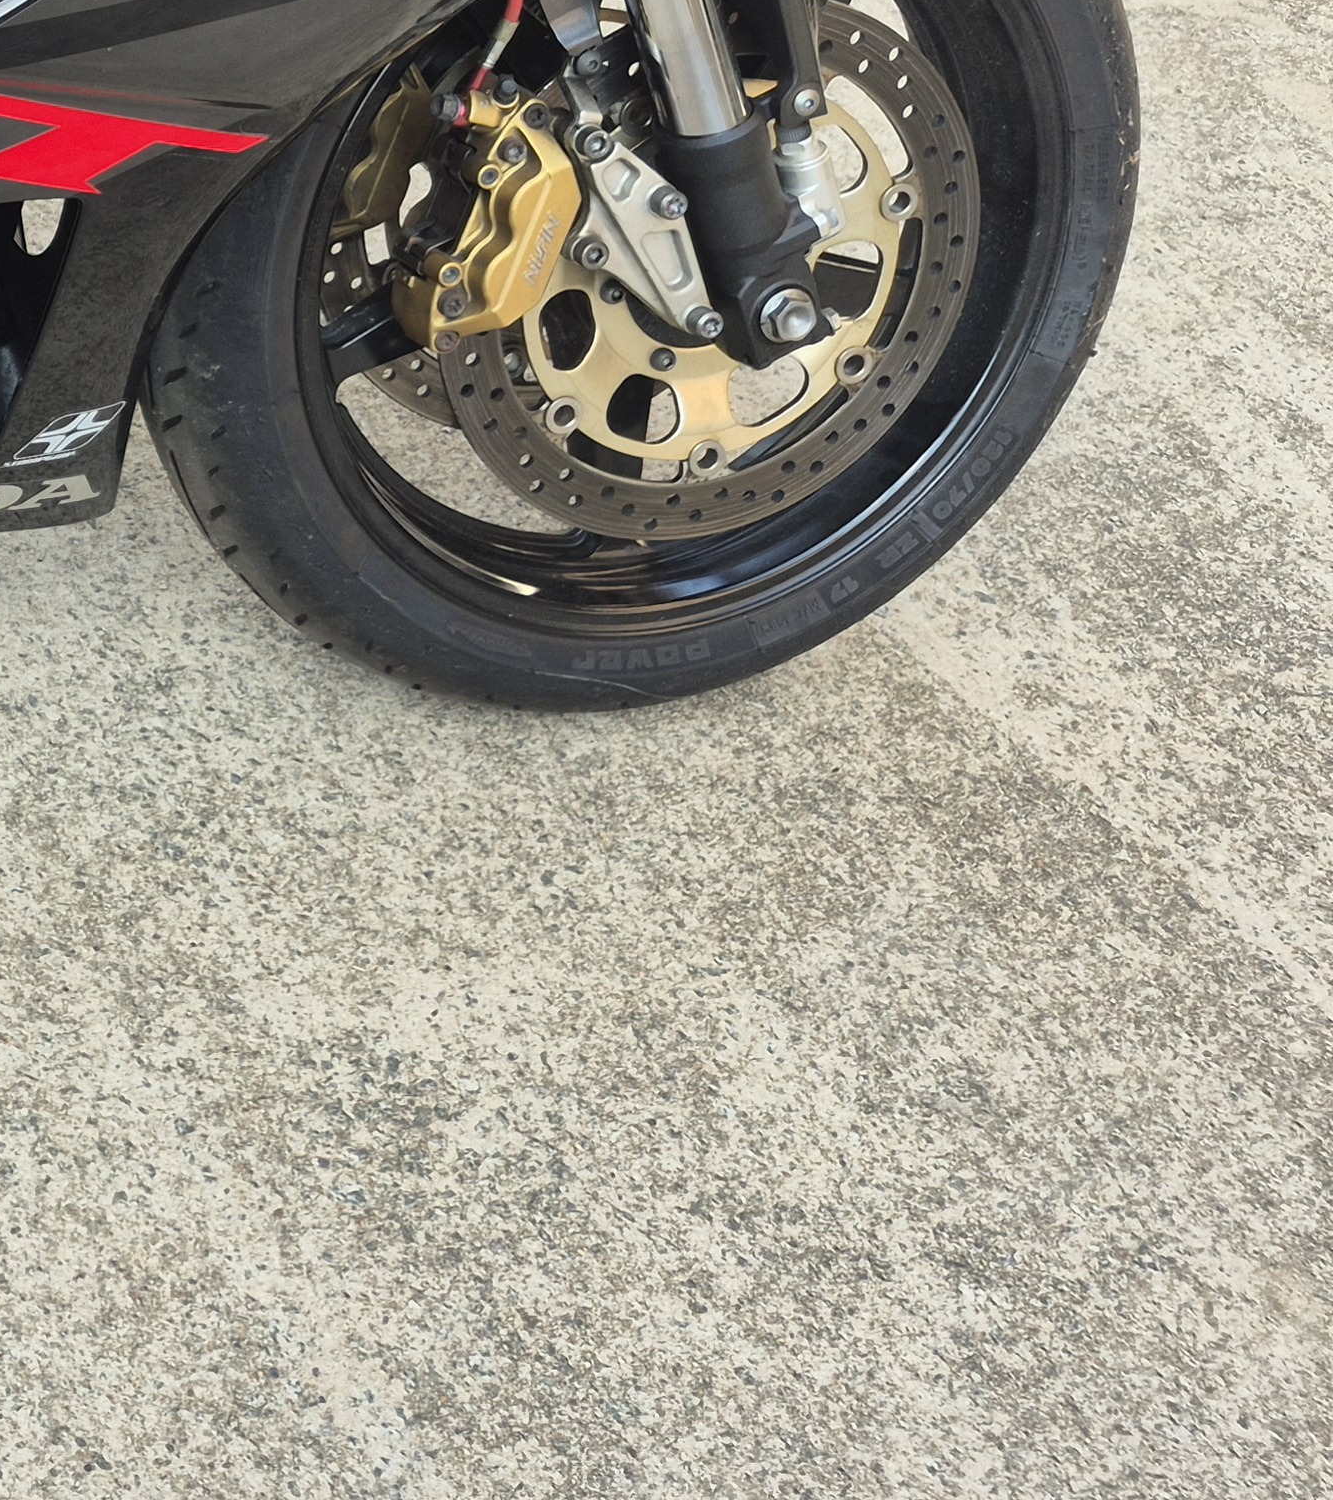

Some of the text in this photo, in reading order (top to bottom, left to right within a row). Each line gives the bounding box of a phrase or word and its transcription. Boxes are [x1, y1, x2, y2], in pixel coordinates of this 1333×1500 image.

[932, 429, 1013, 521] 120/70
[878, 530, 919, 571] ZR
[826, 574, 861, 602] 17
